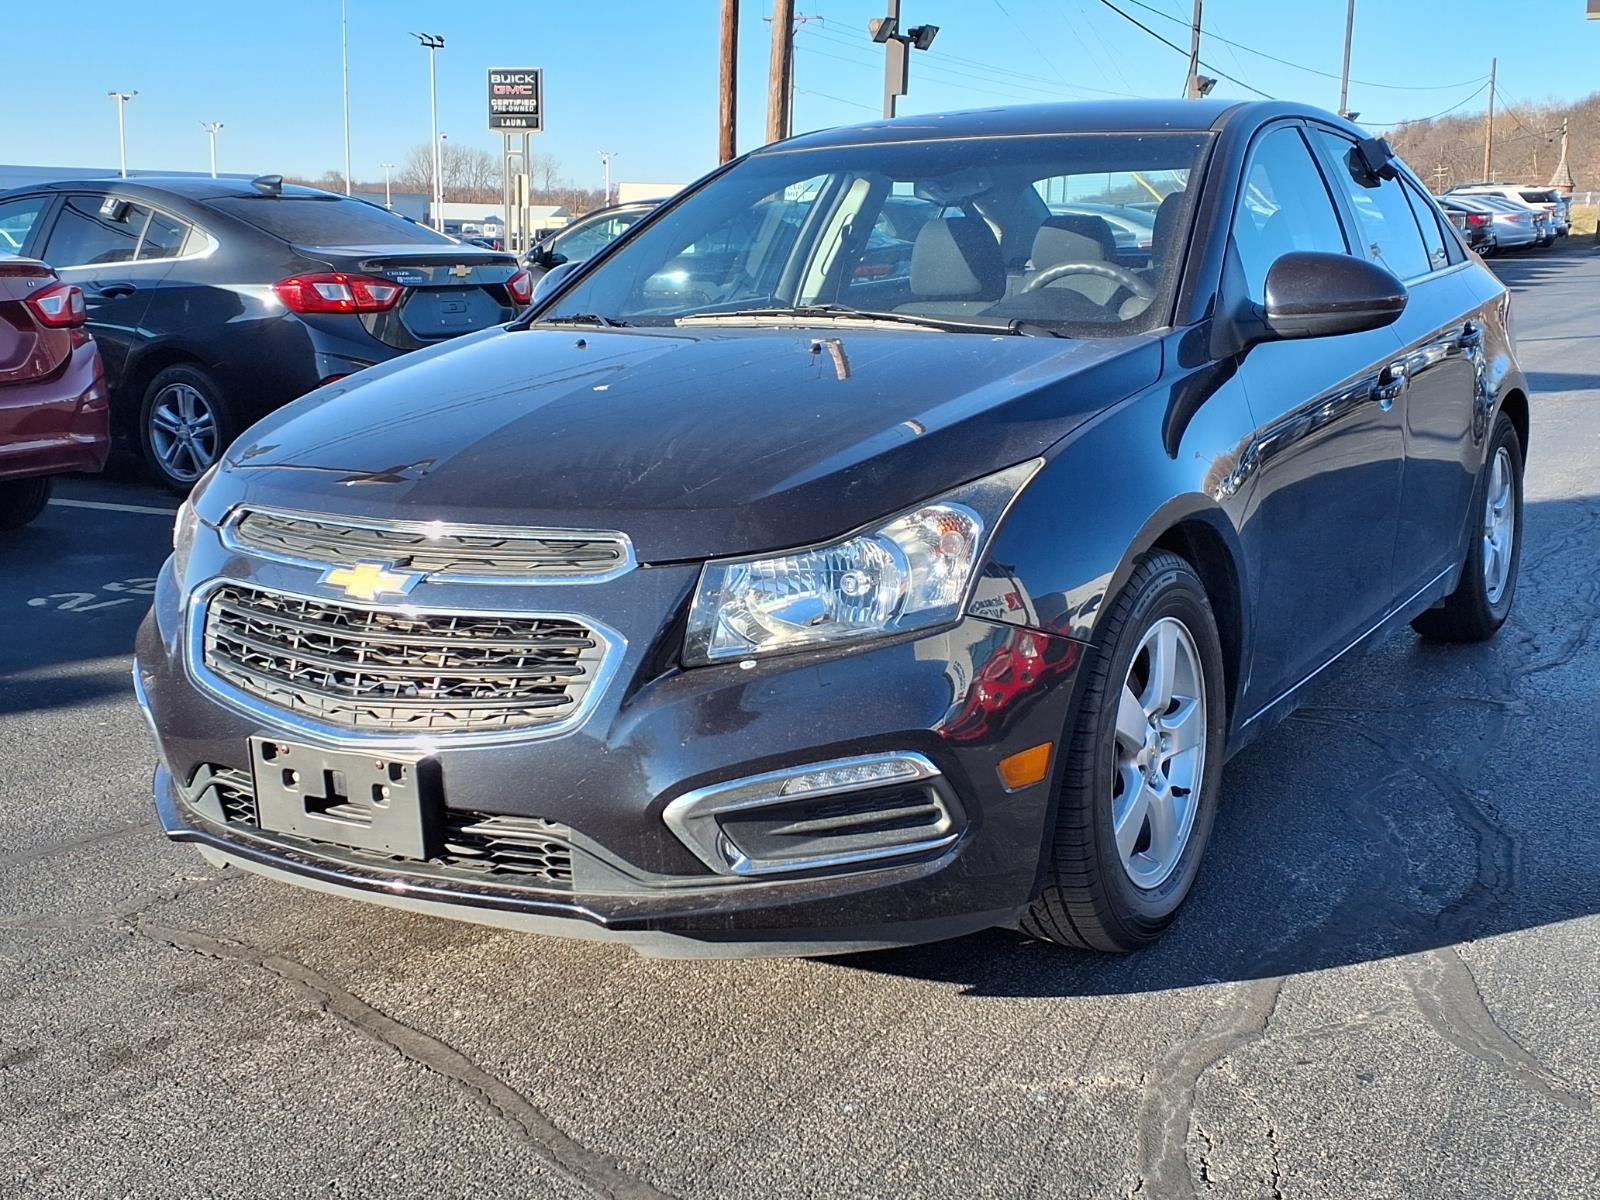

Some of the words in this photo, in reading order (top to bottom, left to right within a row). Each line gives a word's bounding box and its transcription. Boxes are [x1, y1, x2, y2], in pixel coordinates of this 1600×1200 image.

[490, 74, 535, 83] BUICK
[493, 85, 533, 95] GMC
[501, 119, 527, 127] LAURA
